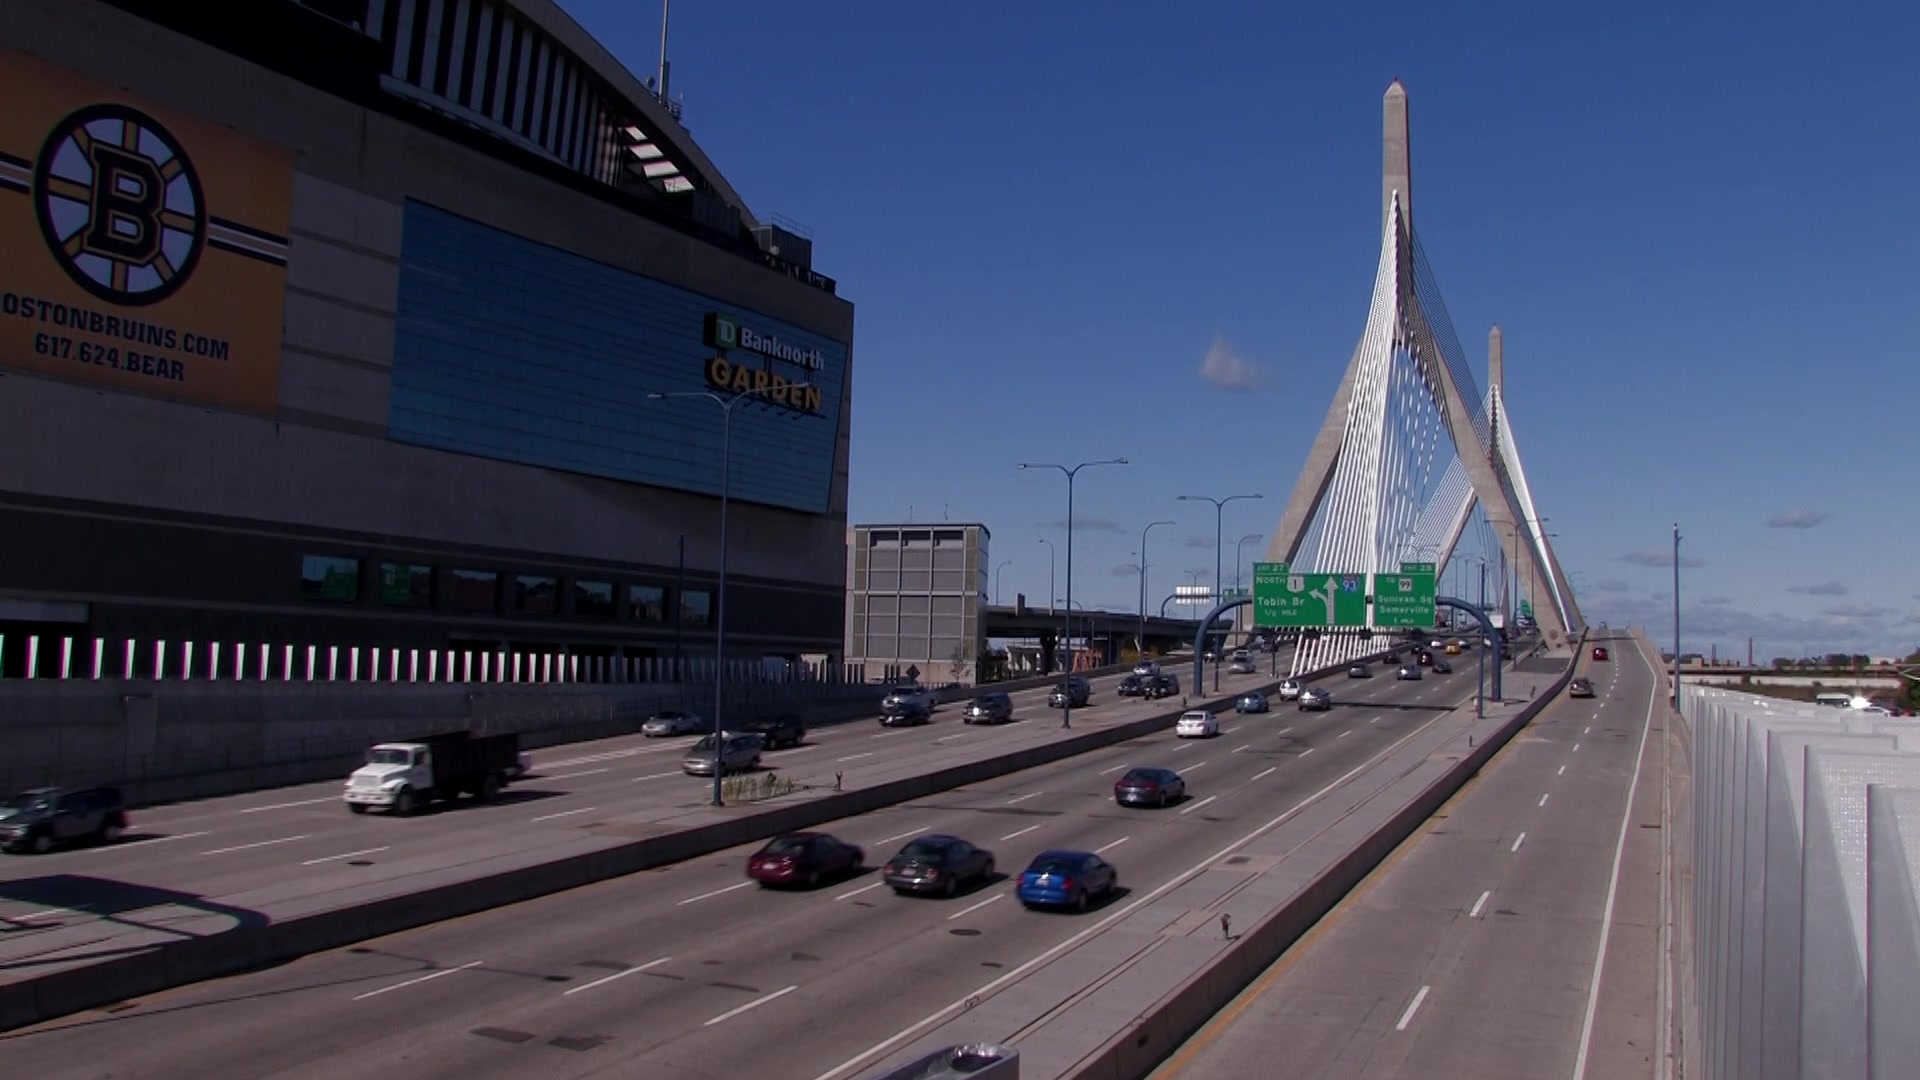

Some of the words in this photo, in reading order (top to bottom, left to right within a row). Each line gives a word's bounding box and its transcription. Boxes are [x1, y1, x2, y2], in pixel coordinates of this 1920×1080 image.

[82, 138, 167, 268] B
[2, 293, 230, 361] OSTONBRUINS.COM
[718, 319, 735, 343] TD
[741, 327, 825, 370] Banknorth
[35, 333, 185, 382] 617.624.BEAR
[709, 356, 822, 414] GARDEN
[1272, 564, 1284, 572] 27
[1256, 576, 1285, 584] NORTH
[1400, 580, 1410, 589] 99
[1342, 580, 1356, 591] 93
[1257, 597, 1286, 606] Tobin
[1292, 597, 1304, 606] Br
[1378, 595, 1415, 603] Sullivan
[1420, 595, 1432, 604] Sq
[1380, 605, 1429, 613] Somerville
